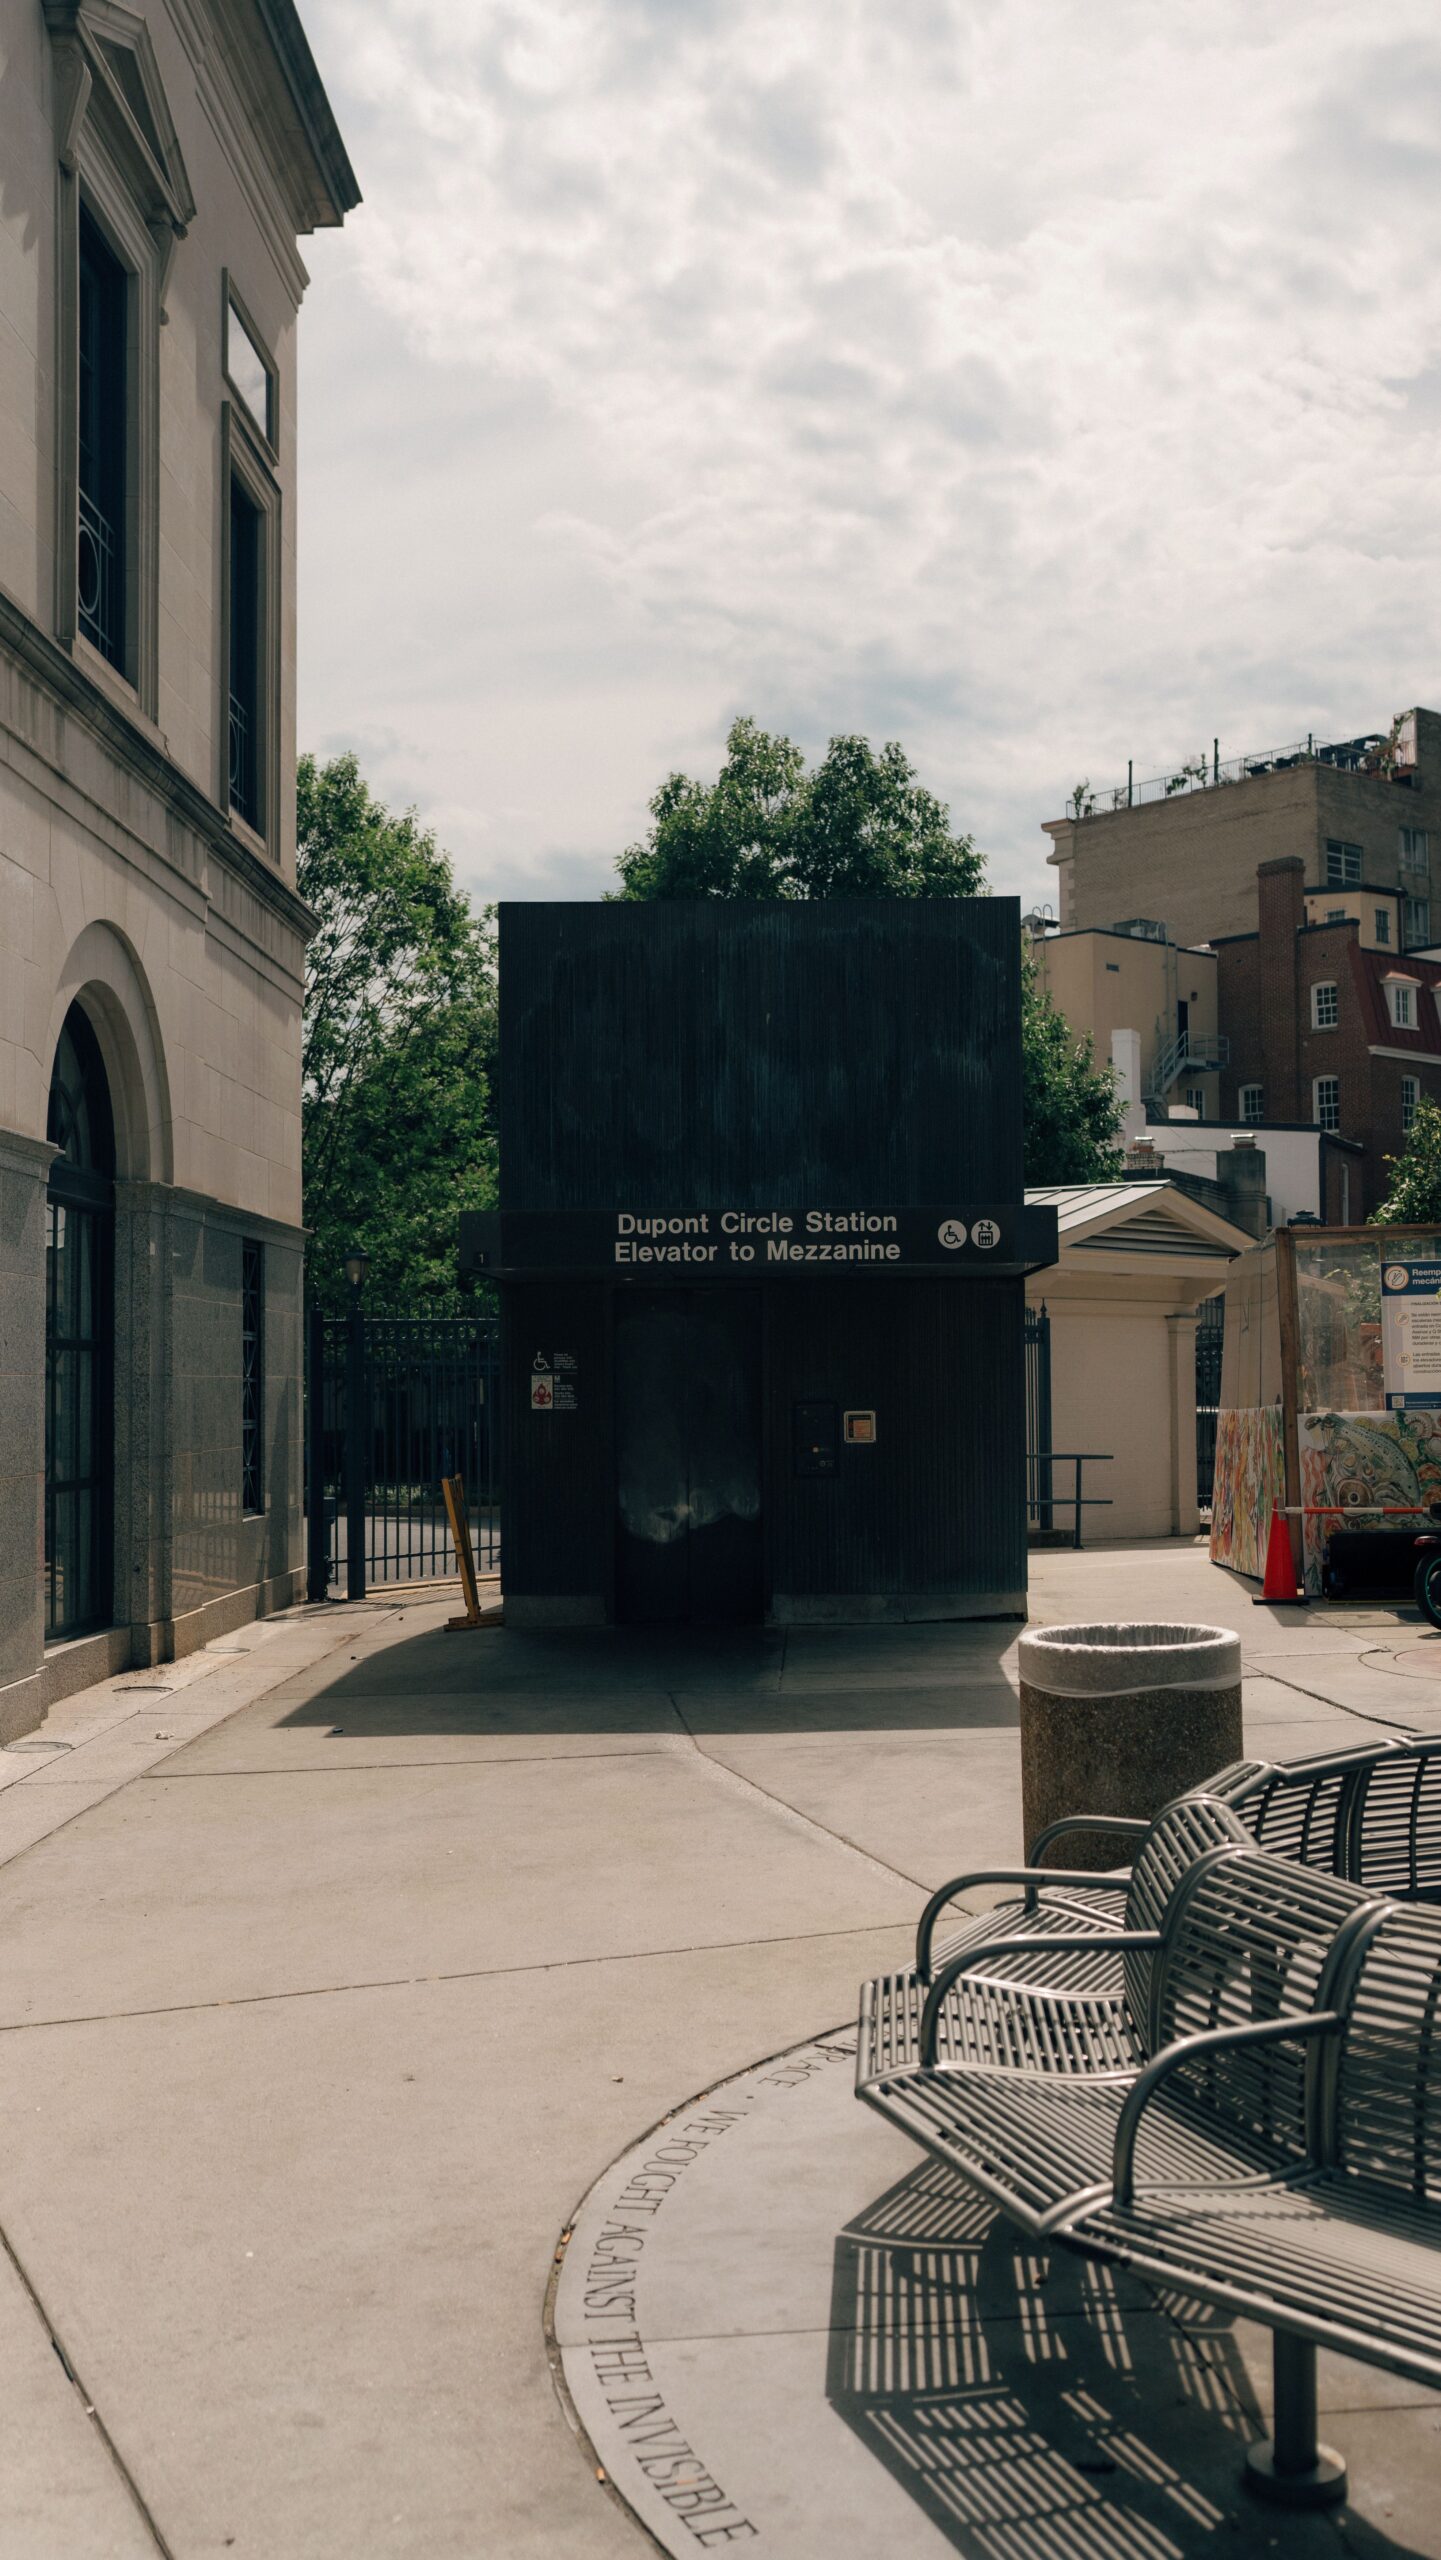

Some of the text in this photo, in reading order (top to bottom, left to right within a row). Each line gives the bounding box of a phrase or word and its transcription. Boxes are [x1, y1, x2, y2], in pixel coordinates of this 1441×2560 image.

[614, 1239, 901, 1263] Elevator to Mezzanine
[617, 1211, 897, 1238] Dupont Circle Station
[683, 2109, 749, 2135] WE
[613, 2137, 711, 2216] FOUGHT
[583, 2220, 649, 2323] AGAINST
[588, 2330, 654, 2386] THE
[606, 2393, 760, 2549] INVISIBLE
